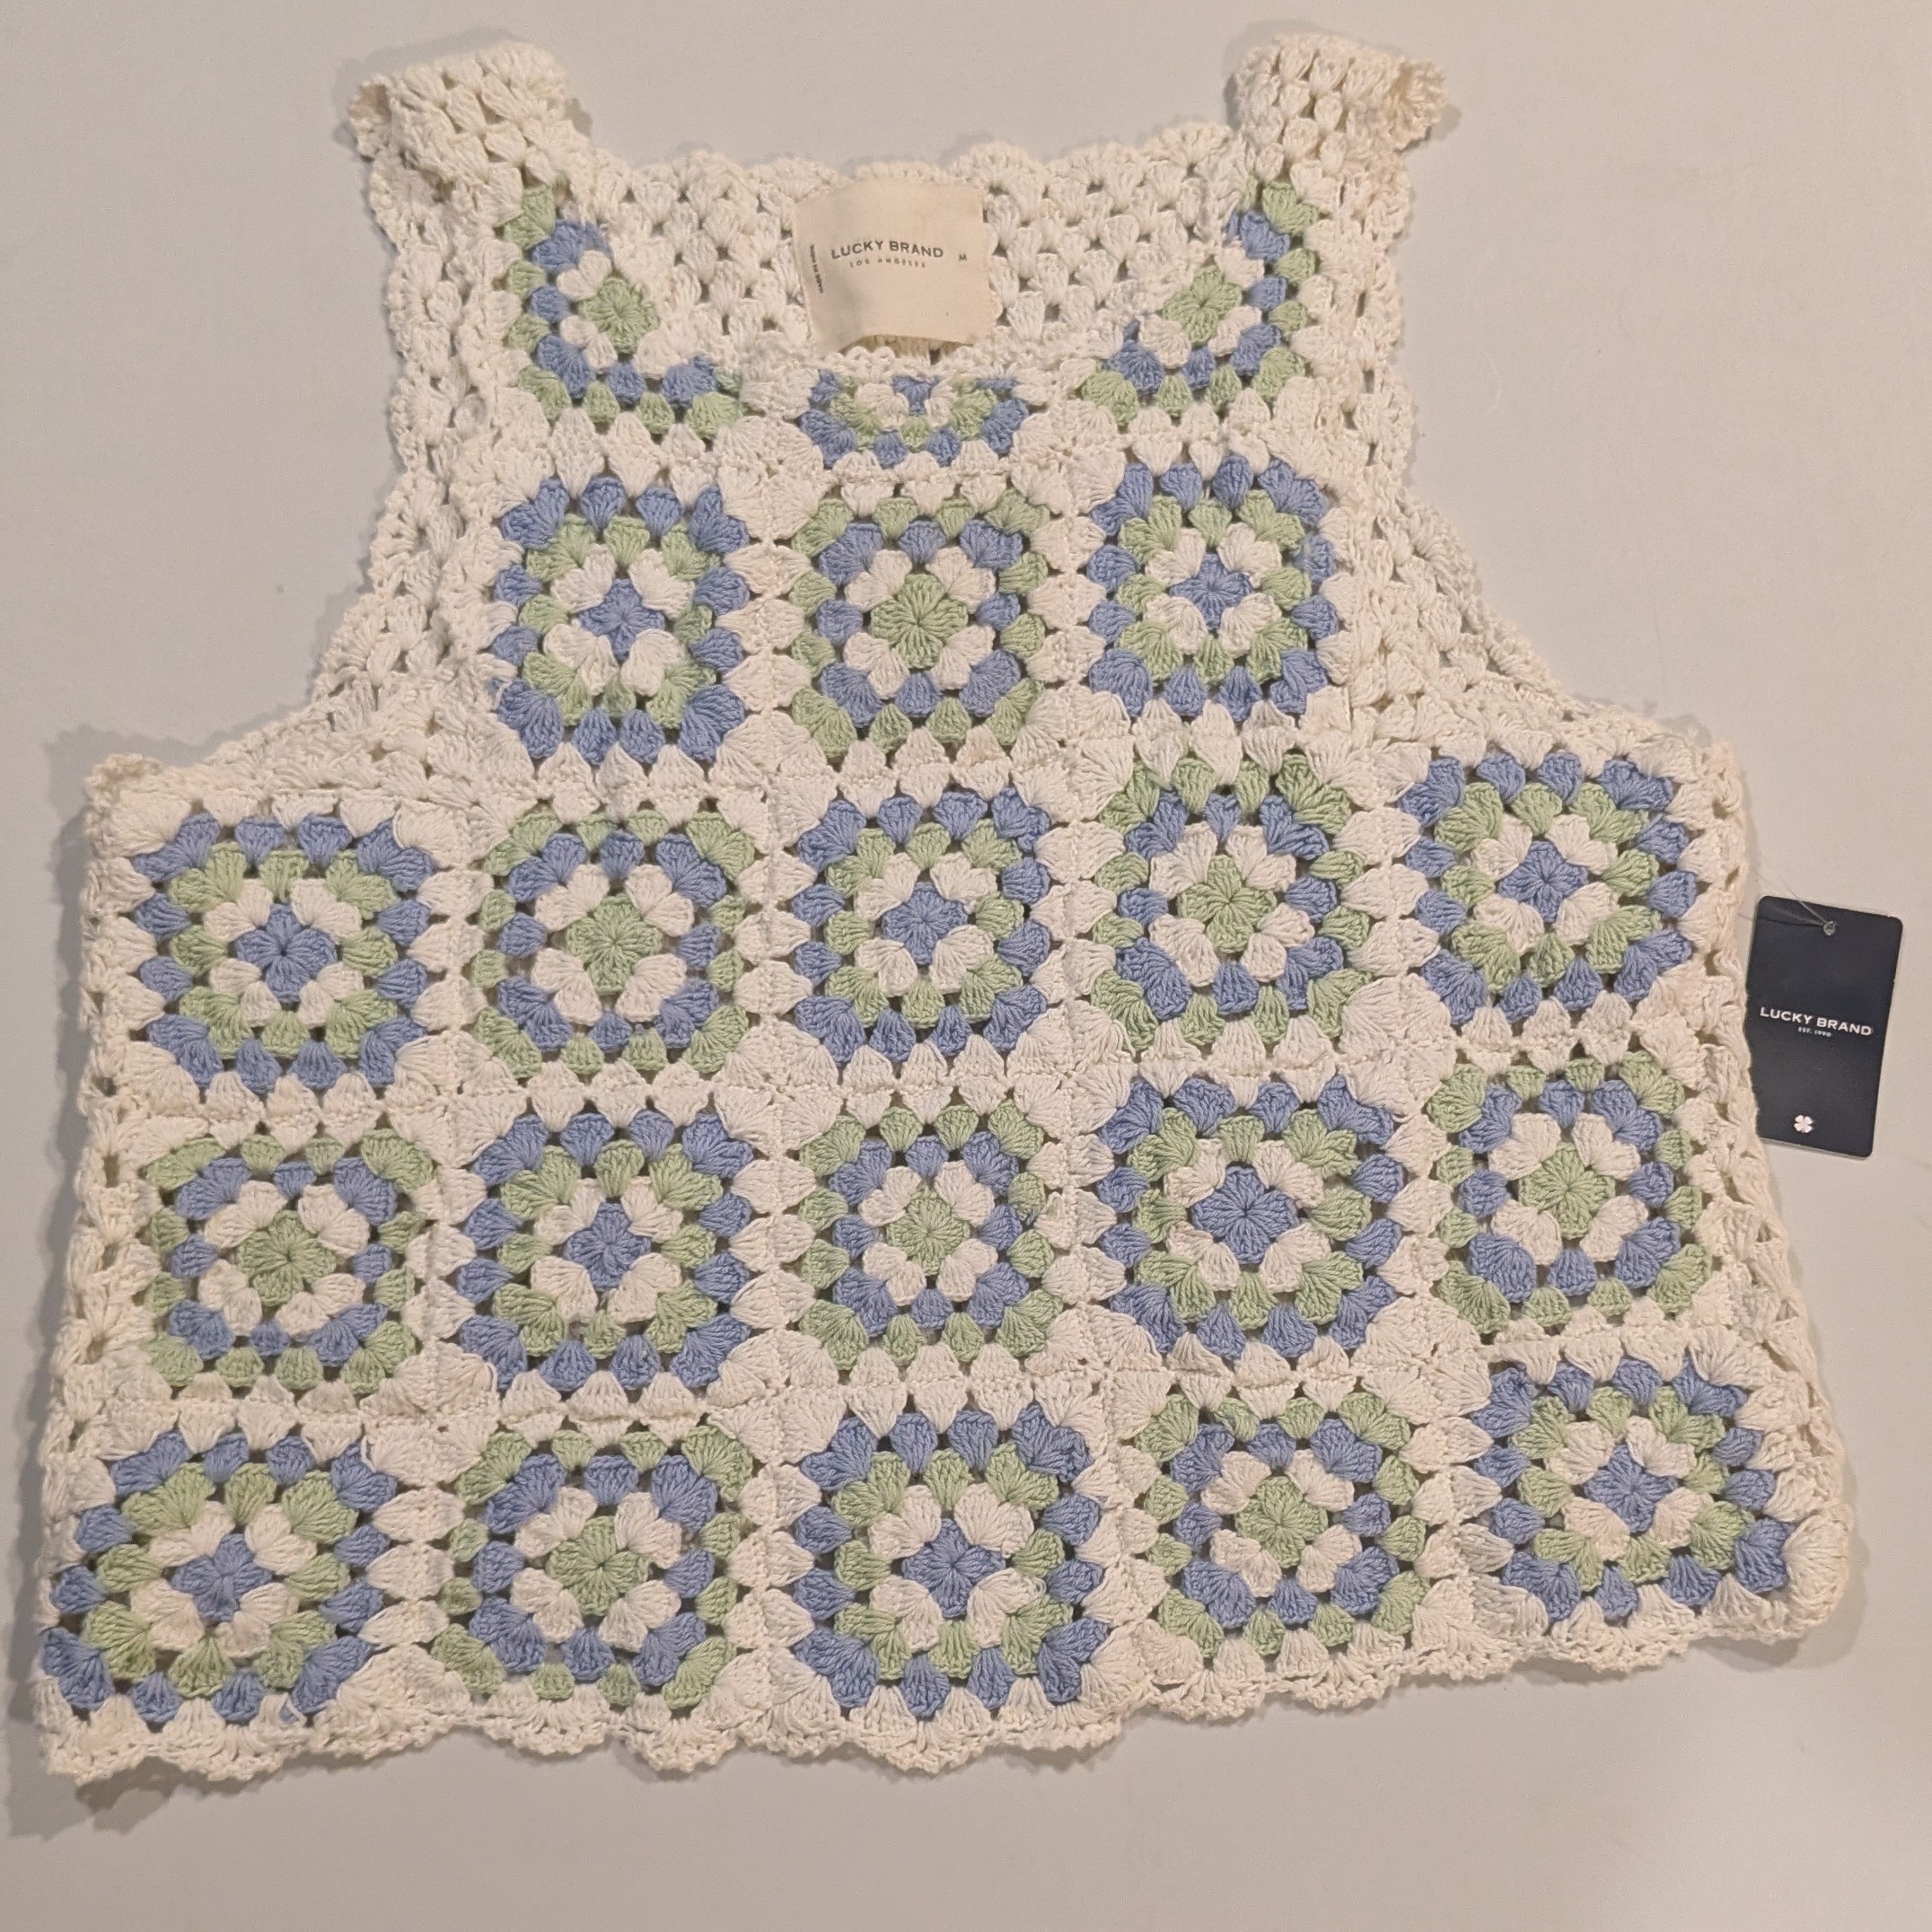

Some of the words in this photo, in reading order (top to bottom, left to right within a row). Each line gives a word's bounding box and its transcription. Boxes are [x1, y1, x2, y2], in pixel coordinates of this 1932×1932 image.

[830, 241, 884, 259] LUCKY
[889, 241, 944, 258] BRAND
[849, 258, 870, 268] LOS
[877, 258, 926, 268] ANGELES
[958, 253, 968, 262] M
[1760, 1006, 1813, 1024] LUCKY
[1816, 1017, 1873, 1036] BRAND
